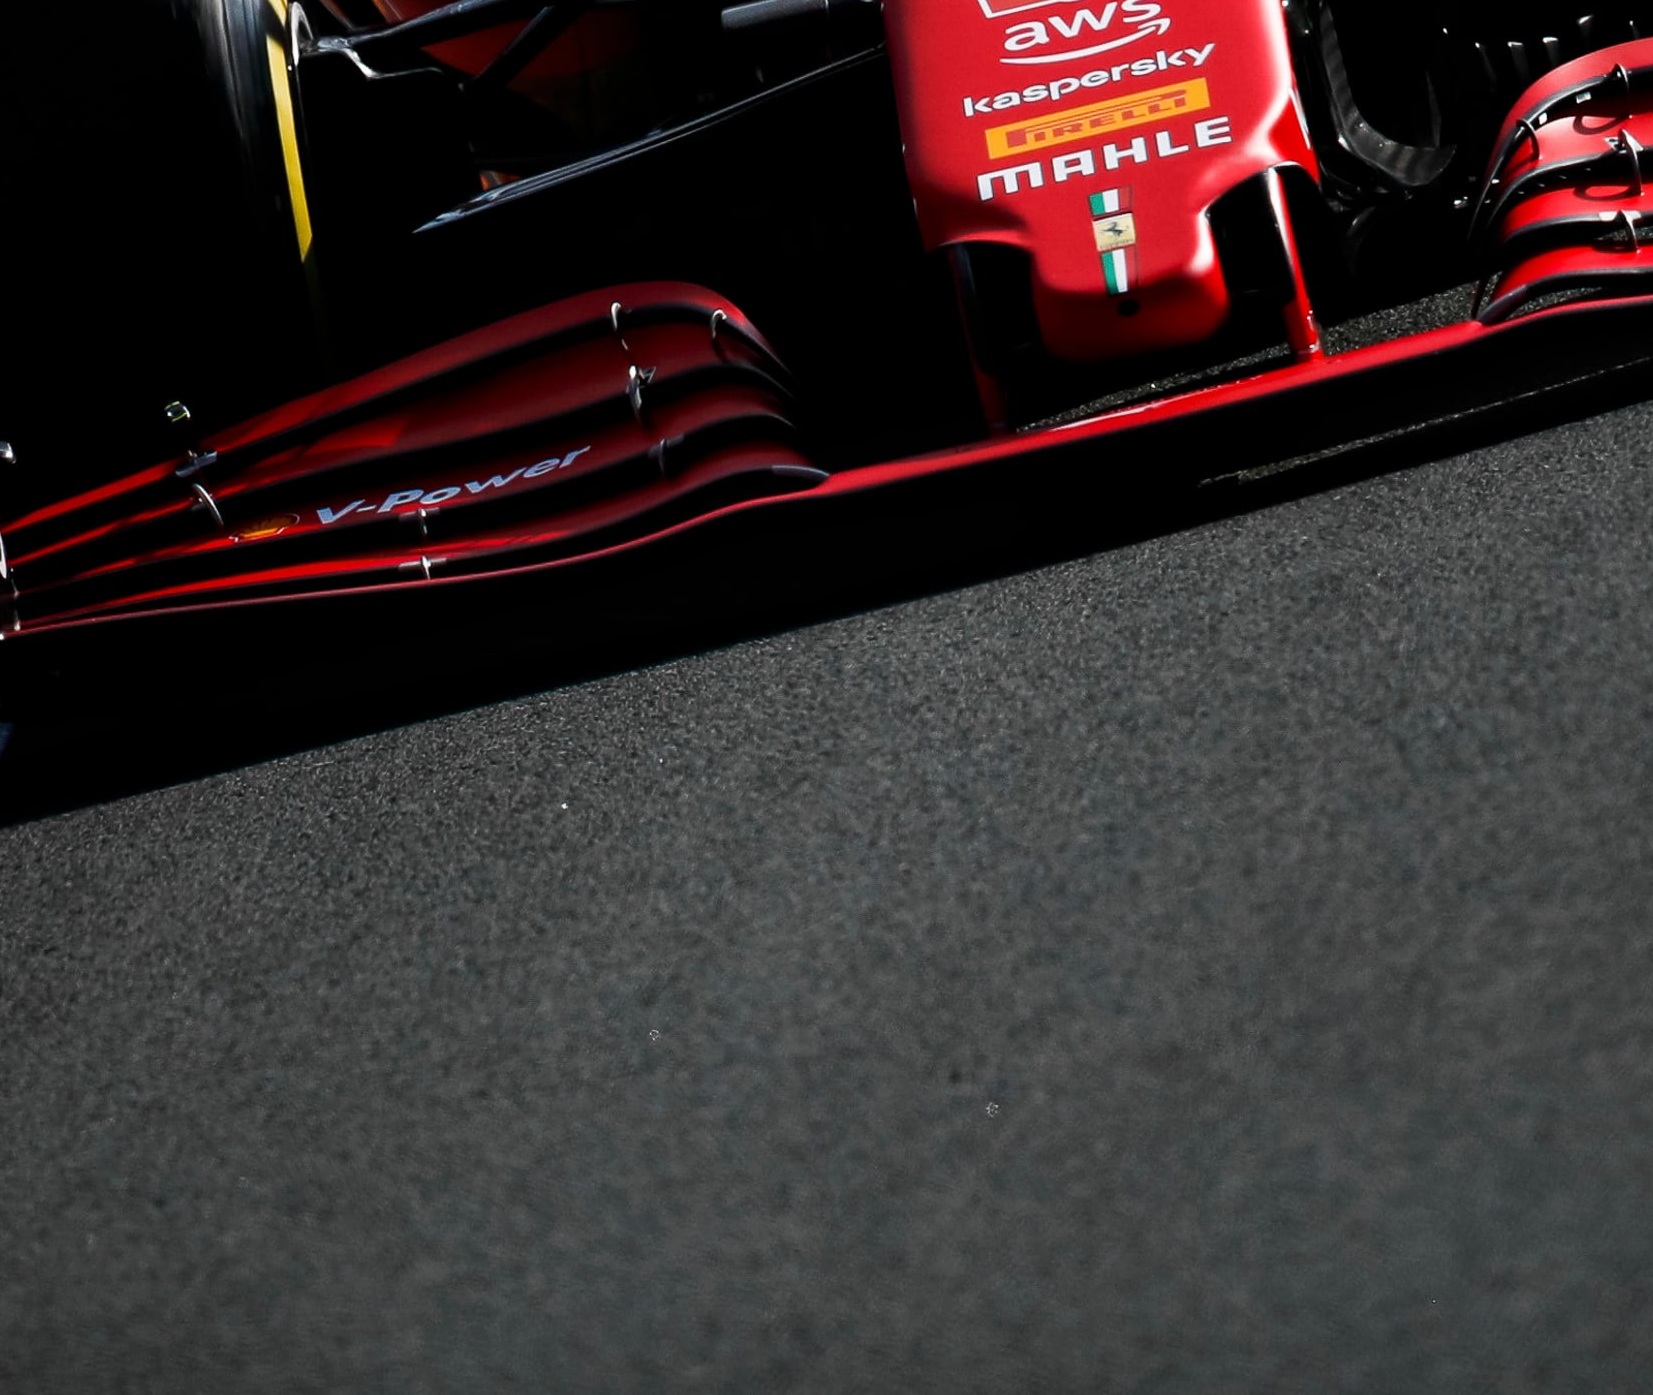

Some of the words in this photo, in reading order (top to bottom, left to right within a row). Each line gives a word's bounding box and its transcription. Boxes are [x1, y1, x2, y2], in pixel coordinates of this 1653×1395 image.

[963, 43, 1215, 117] kaspersky
[1006, 89, 1187, 149] PIRELLI
[977, 116, 1233, 202] MAHLE
[316, 445, 591, 524] V-Power
